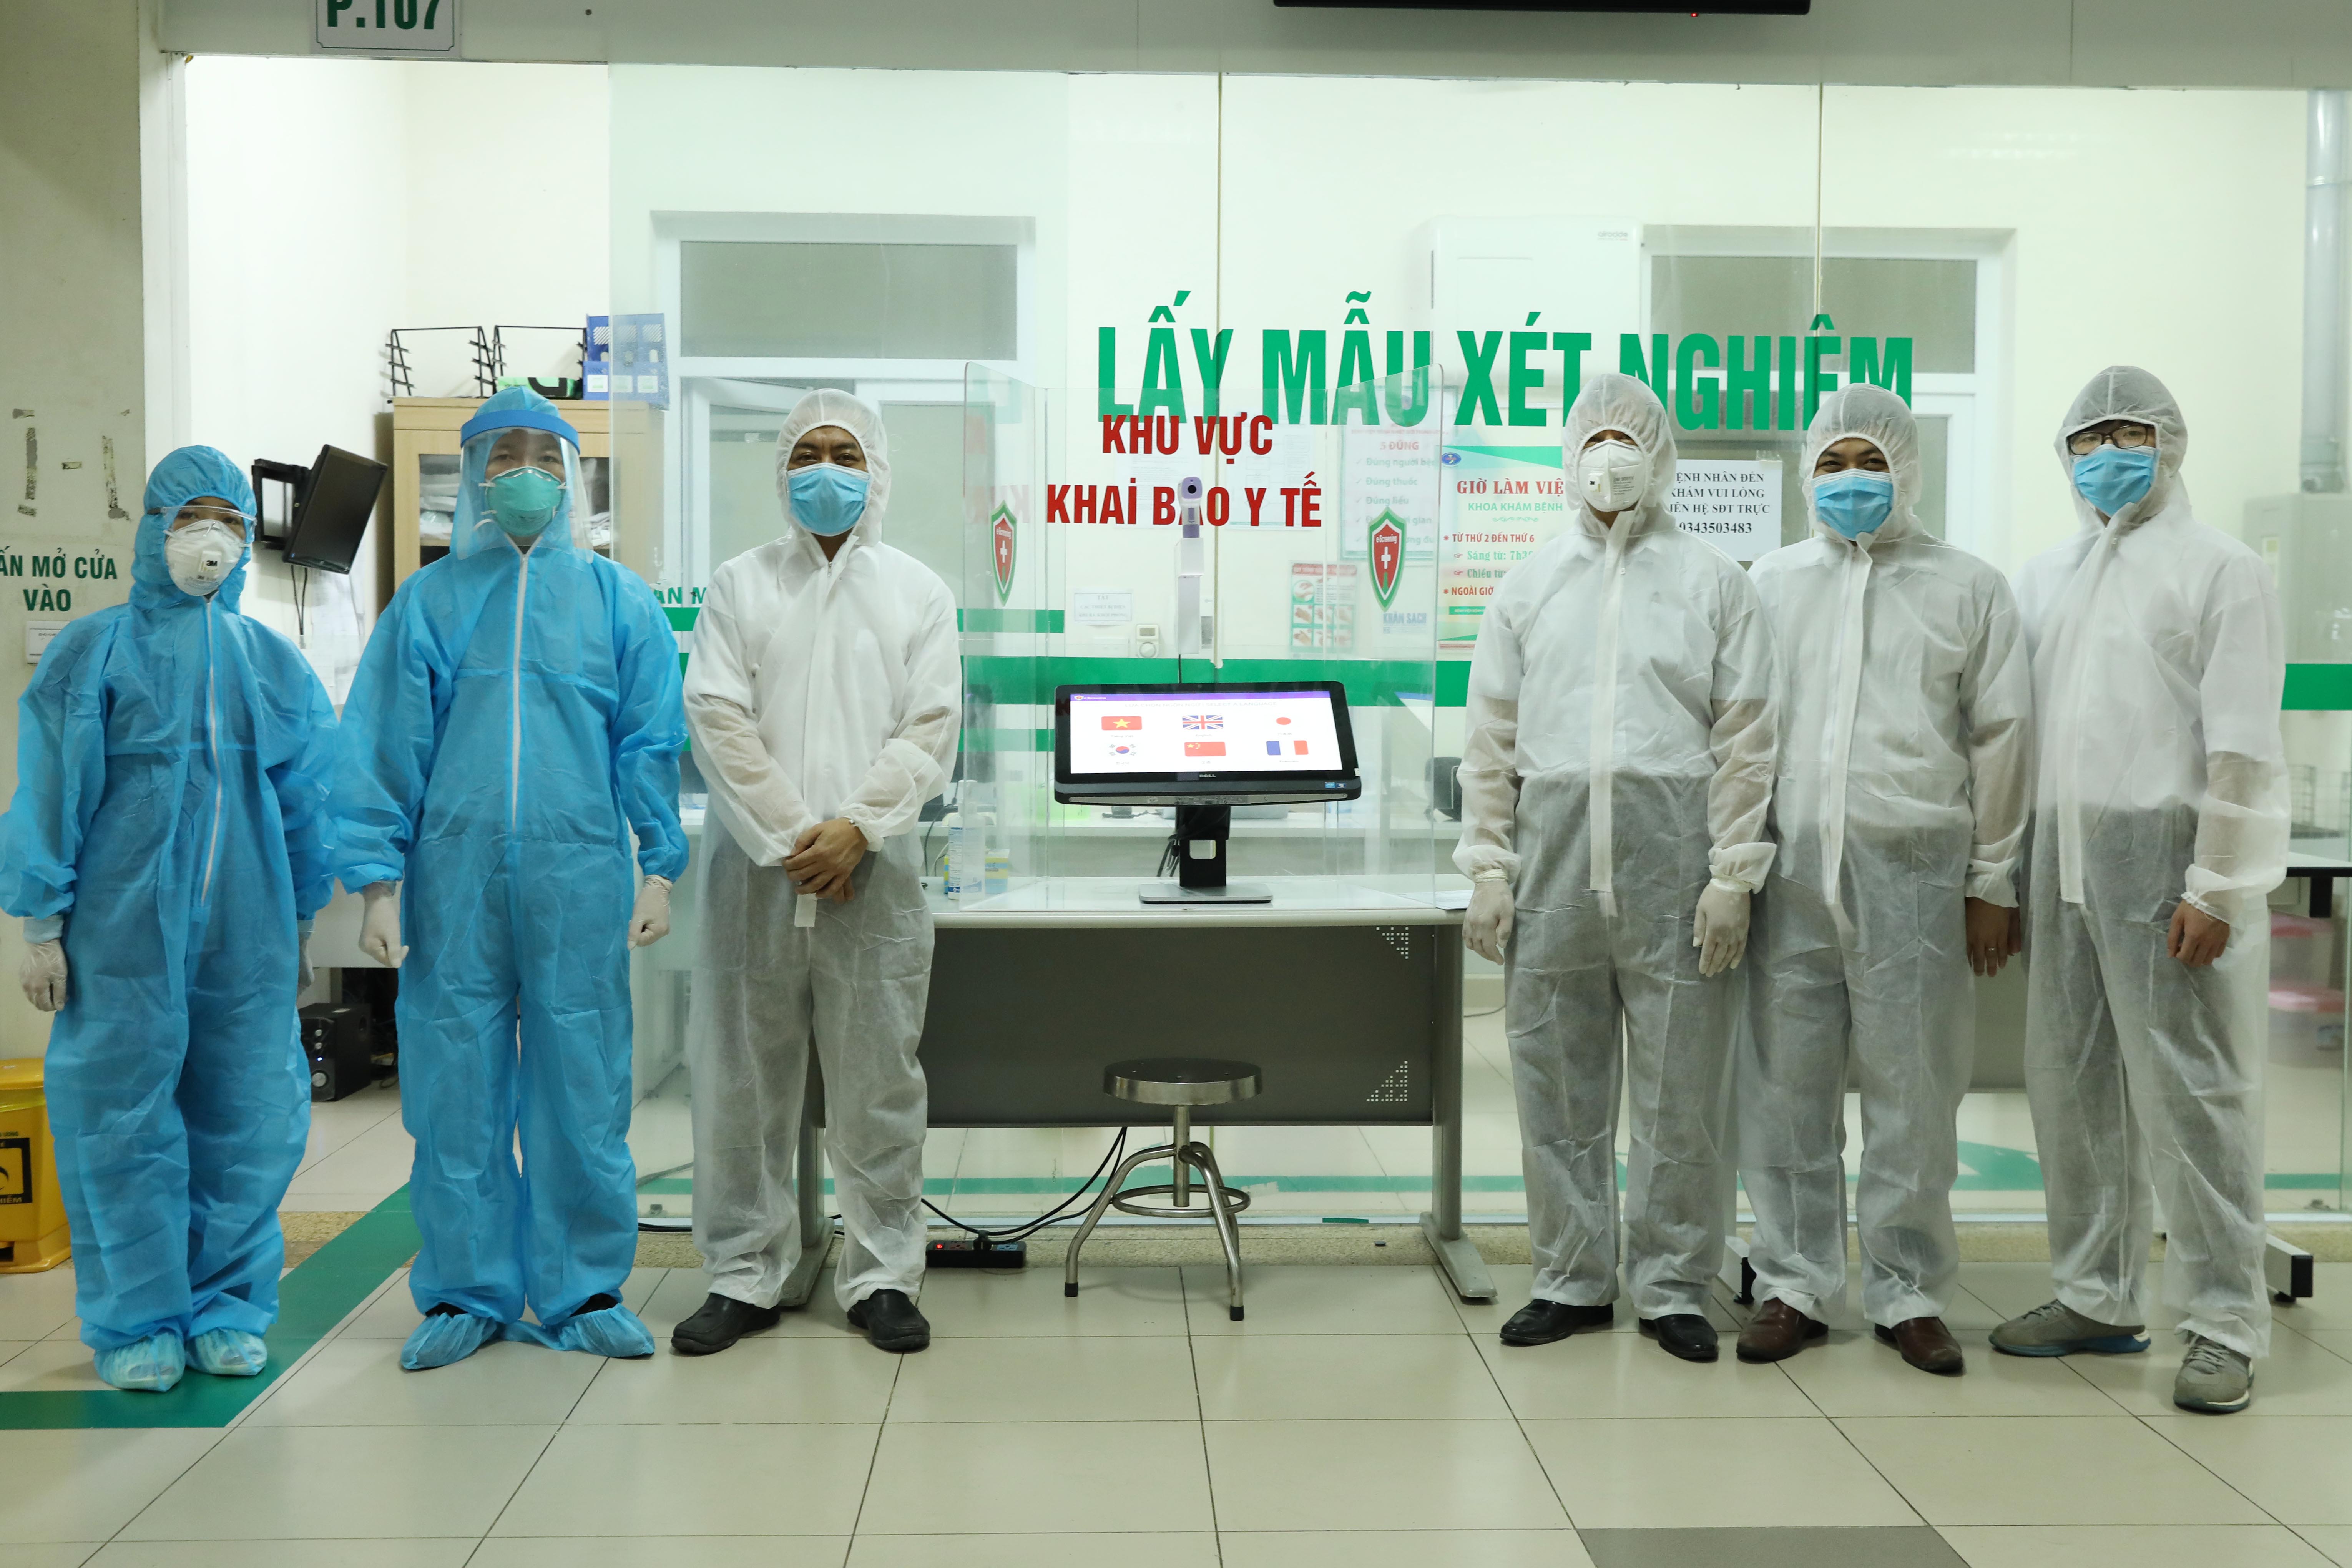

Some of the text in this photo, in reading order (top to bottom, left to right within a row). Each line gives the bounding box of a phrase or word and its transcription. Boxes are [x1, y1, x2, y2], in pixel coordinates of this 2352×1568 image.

[1098, 290, 1234, 424] LẤY
[1262, 291, 1430, 427] MẪU
[1454, 312, 1592, 427] XÉT
[1103, 412, 1272, 464] KHU VỰC
[1704, 471, 1737, 482] NHÂN
[1740, 471, 1764, 482] ĐẾN
[1457, 478, 1487, 494] GIỜ
[1493, 478, 1529, 494] LÀM
[1708, 488, 1728, 498] VUI
[1732, 487, 1765, 498] LÒNG
[1153, 486, 1230, 527] BO
[1244, 488, 1267, 526] Y
[1280, 471, 1321, 527] TẾ
[1468, 501, 1563, 513] KHOA KHÁM BỆNH
[1693, 503, 1709, 515] HỆ
[1712, 504, 1734, 513] SĐT
[1737, 503, 1770, 515] TRỰC
[1679, 522, 1752, 533] 0343503483
[1485, 534, 1489, 542] 2
[1467, 551, 1490, 561] Sáng
[32, 547, 67, 578] MỞ
[75, 548, 117, 580] CỬA
[1452, 585, 1477, 595] NGOÀI
[23, 583, 71, 611] VÀO
